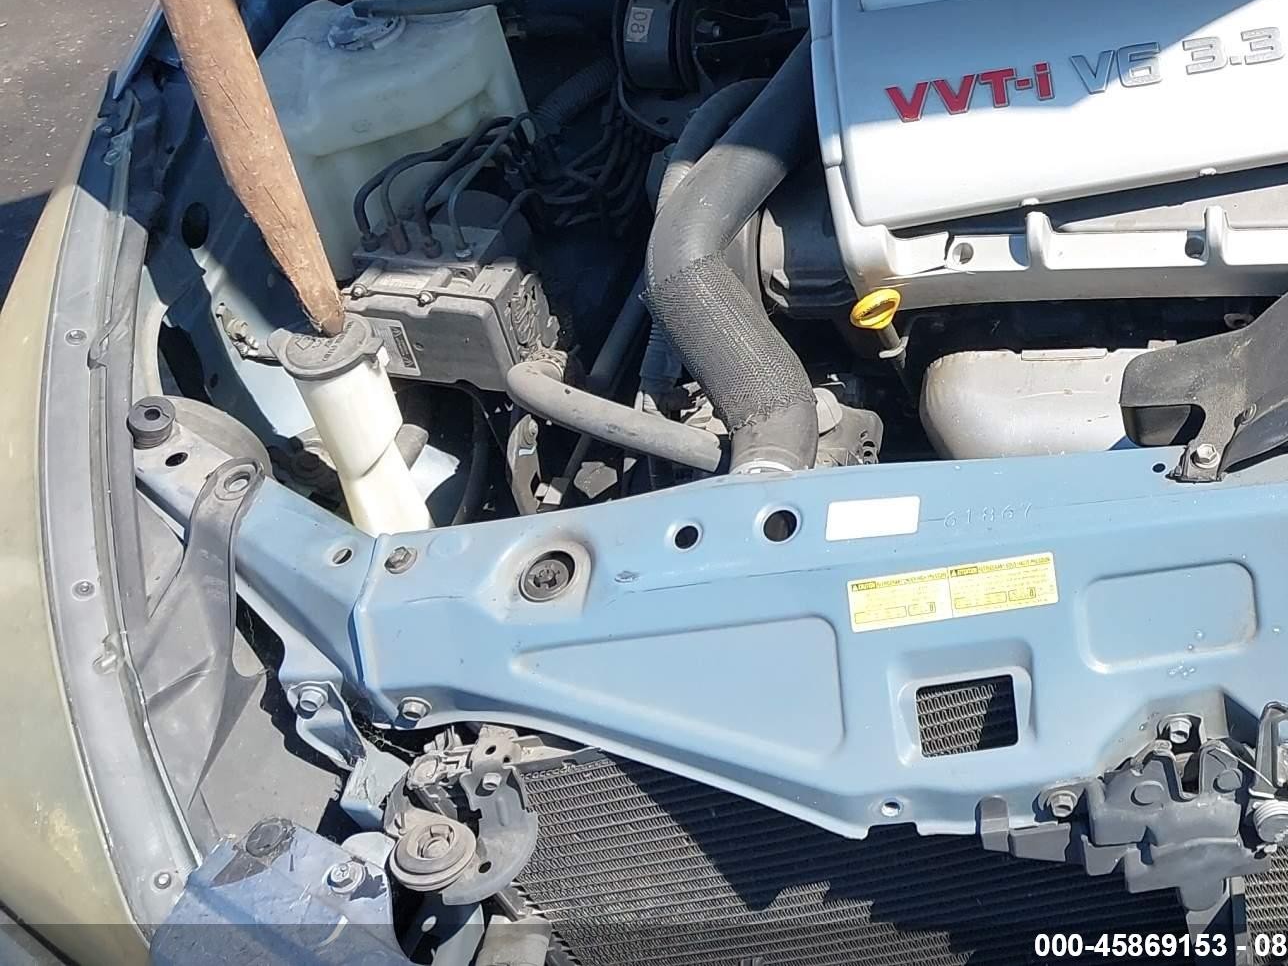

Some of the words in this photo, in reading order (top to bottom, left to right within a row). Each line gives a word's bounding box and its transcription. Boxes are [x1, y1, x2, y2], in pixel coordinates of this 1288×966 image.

[631, 12, 648, 34] 08
[885, 61, 1056, 123] VVT-i
[1070, 41, 1162, 95] V6
[1182, 26, 1286, 75] 3.3
